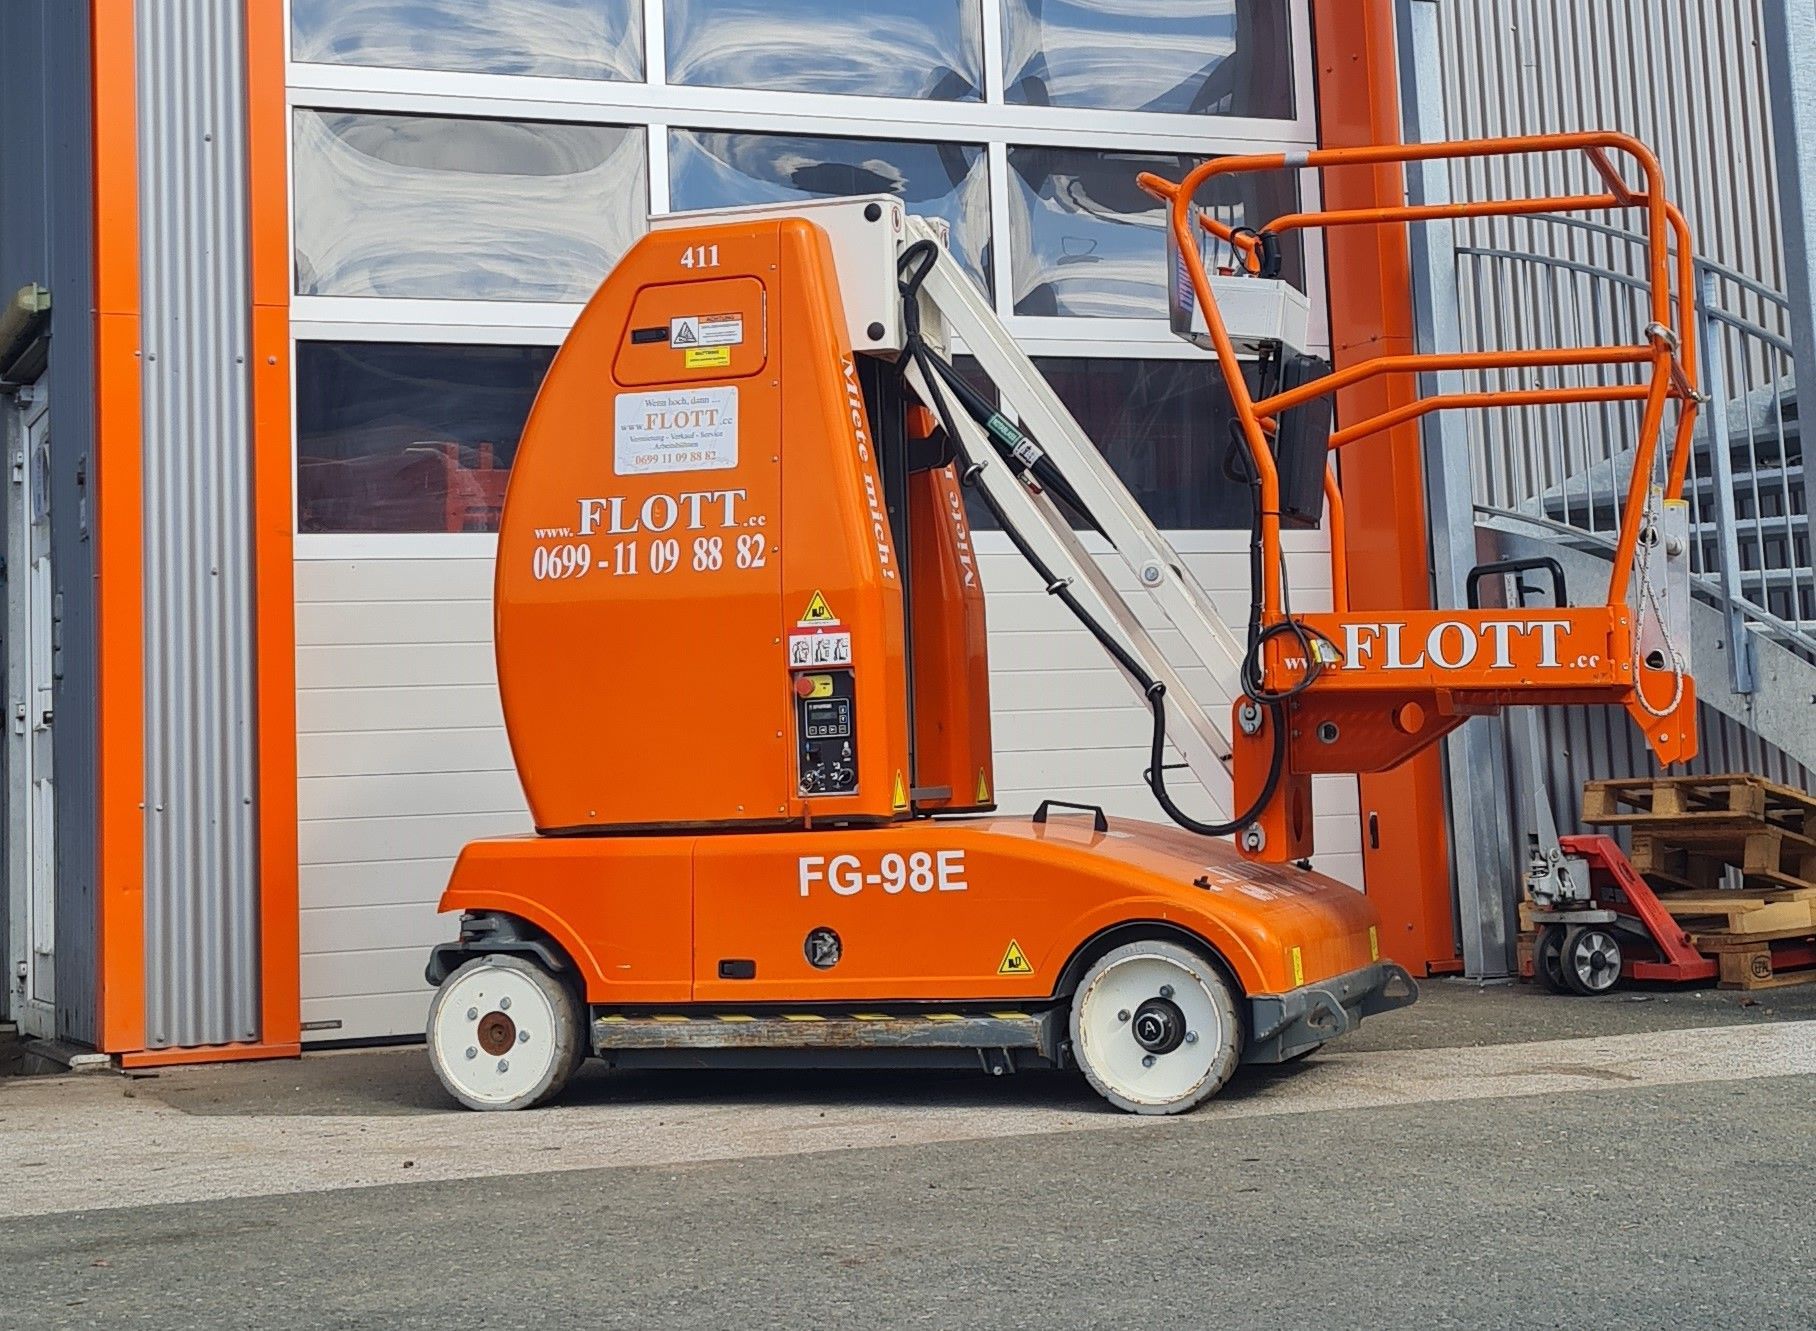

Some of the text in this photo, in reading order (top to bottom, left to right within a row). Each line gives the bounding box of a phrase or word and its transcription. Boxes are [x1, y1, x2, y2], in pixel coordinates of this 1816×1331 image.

[680, 244, 721, 269] 411
[644, 399, 667, 407] Wenn
[668, 397, 690, 406] hoch,
[690, 397, 710, 405] dann
[841, 354, 870, 463] Miete
[635, 450, 717, 465] 0699 11 09 88 82
[533, 489, 768, 540] www.FLOTT.cc
[649, 537, 681, 575] 09
[692, 536, 724, 572] 88
[735, 532, 767, 569] 82
[949, 490, 978, 591] Miete
[798, 849, 968, 897] FG-98E
